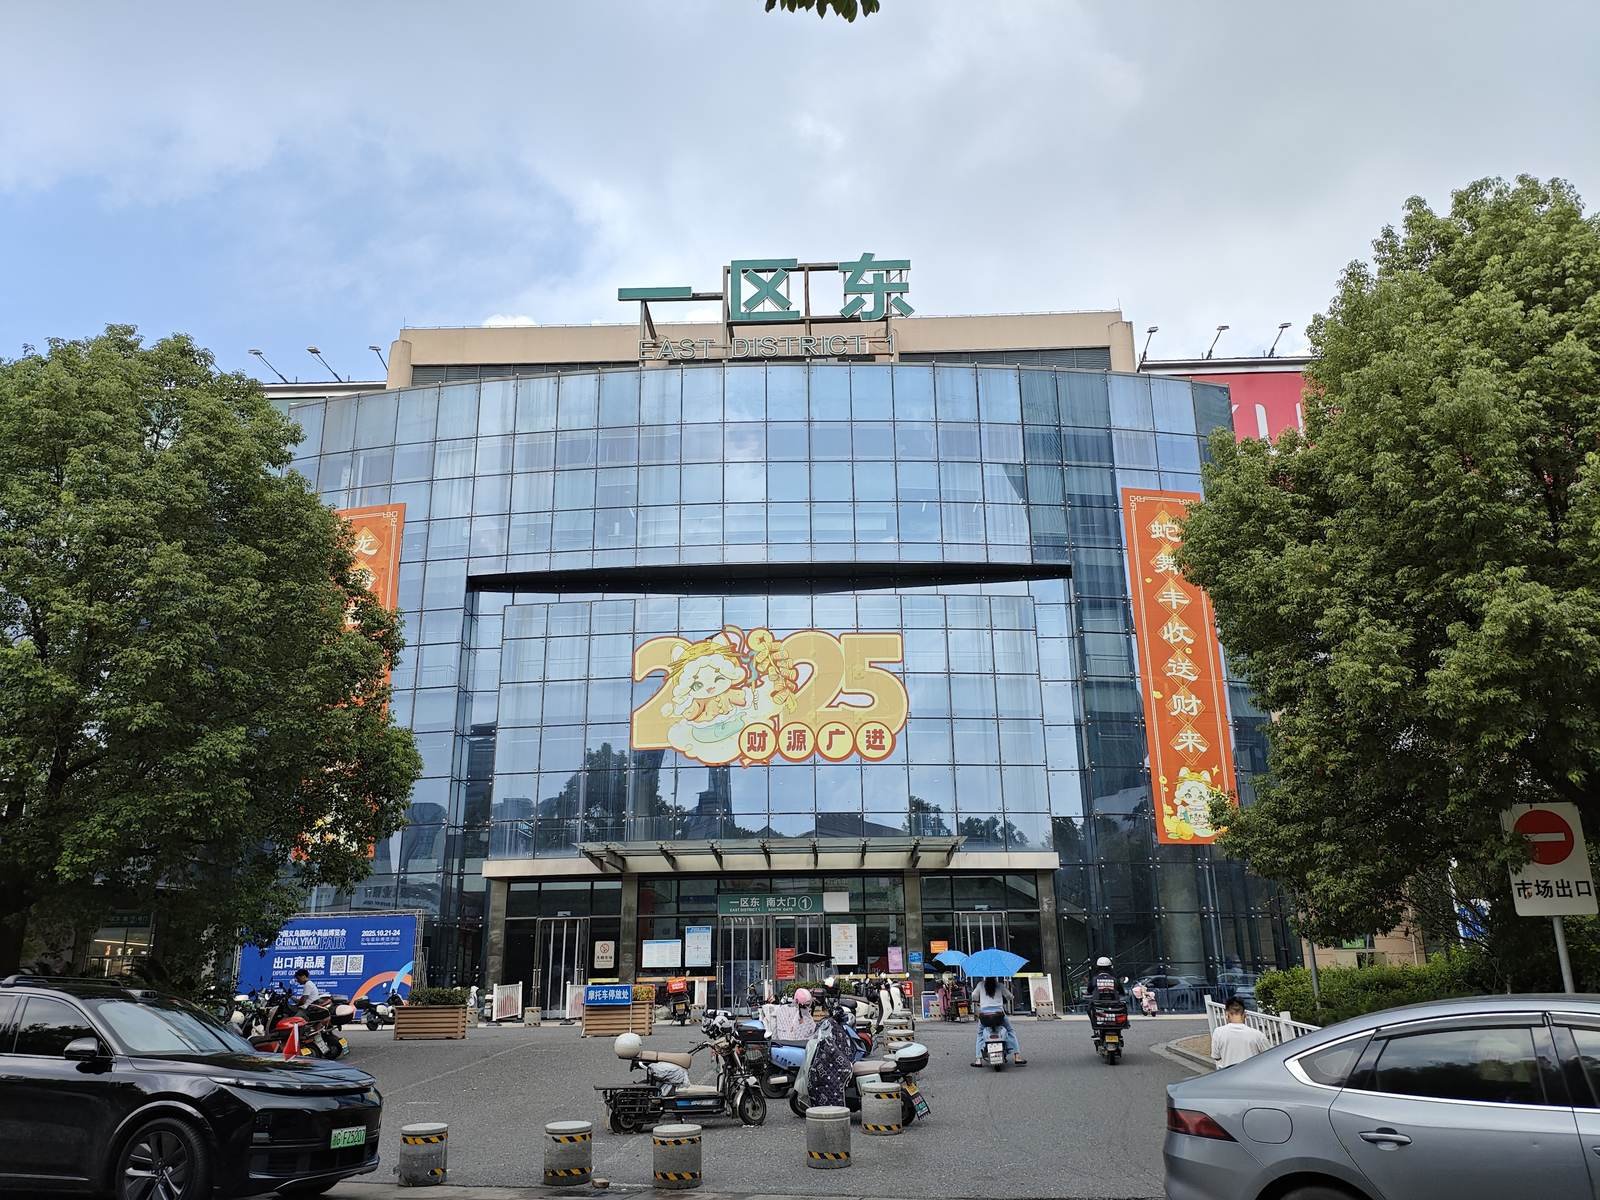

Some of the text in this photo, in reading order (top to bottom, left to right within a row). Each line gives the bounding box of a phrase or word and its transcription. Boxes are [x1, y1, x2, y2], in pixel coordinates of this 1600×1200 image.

[617, 252, 916, 322] 一区东
[638, 338, 716, 360] EAST
[732, 334, 867, 359] DISTRICT
[746, 728, 886, 753] 财源广进
[1514, 878, 1593, 900] 市场出口
[729, 896, 760, 908] 一区东
[766, 896, 797, 908] 南大门
[272, 955, 326, 969] 出口商品展
[587, 989, 630, 1001] 摩托车停放处
